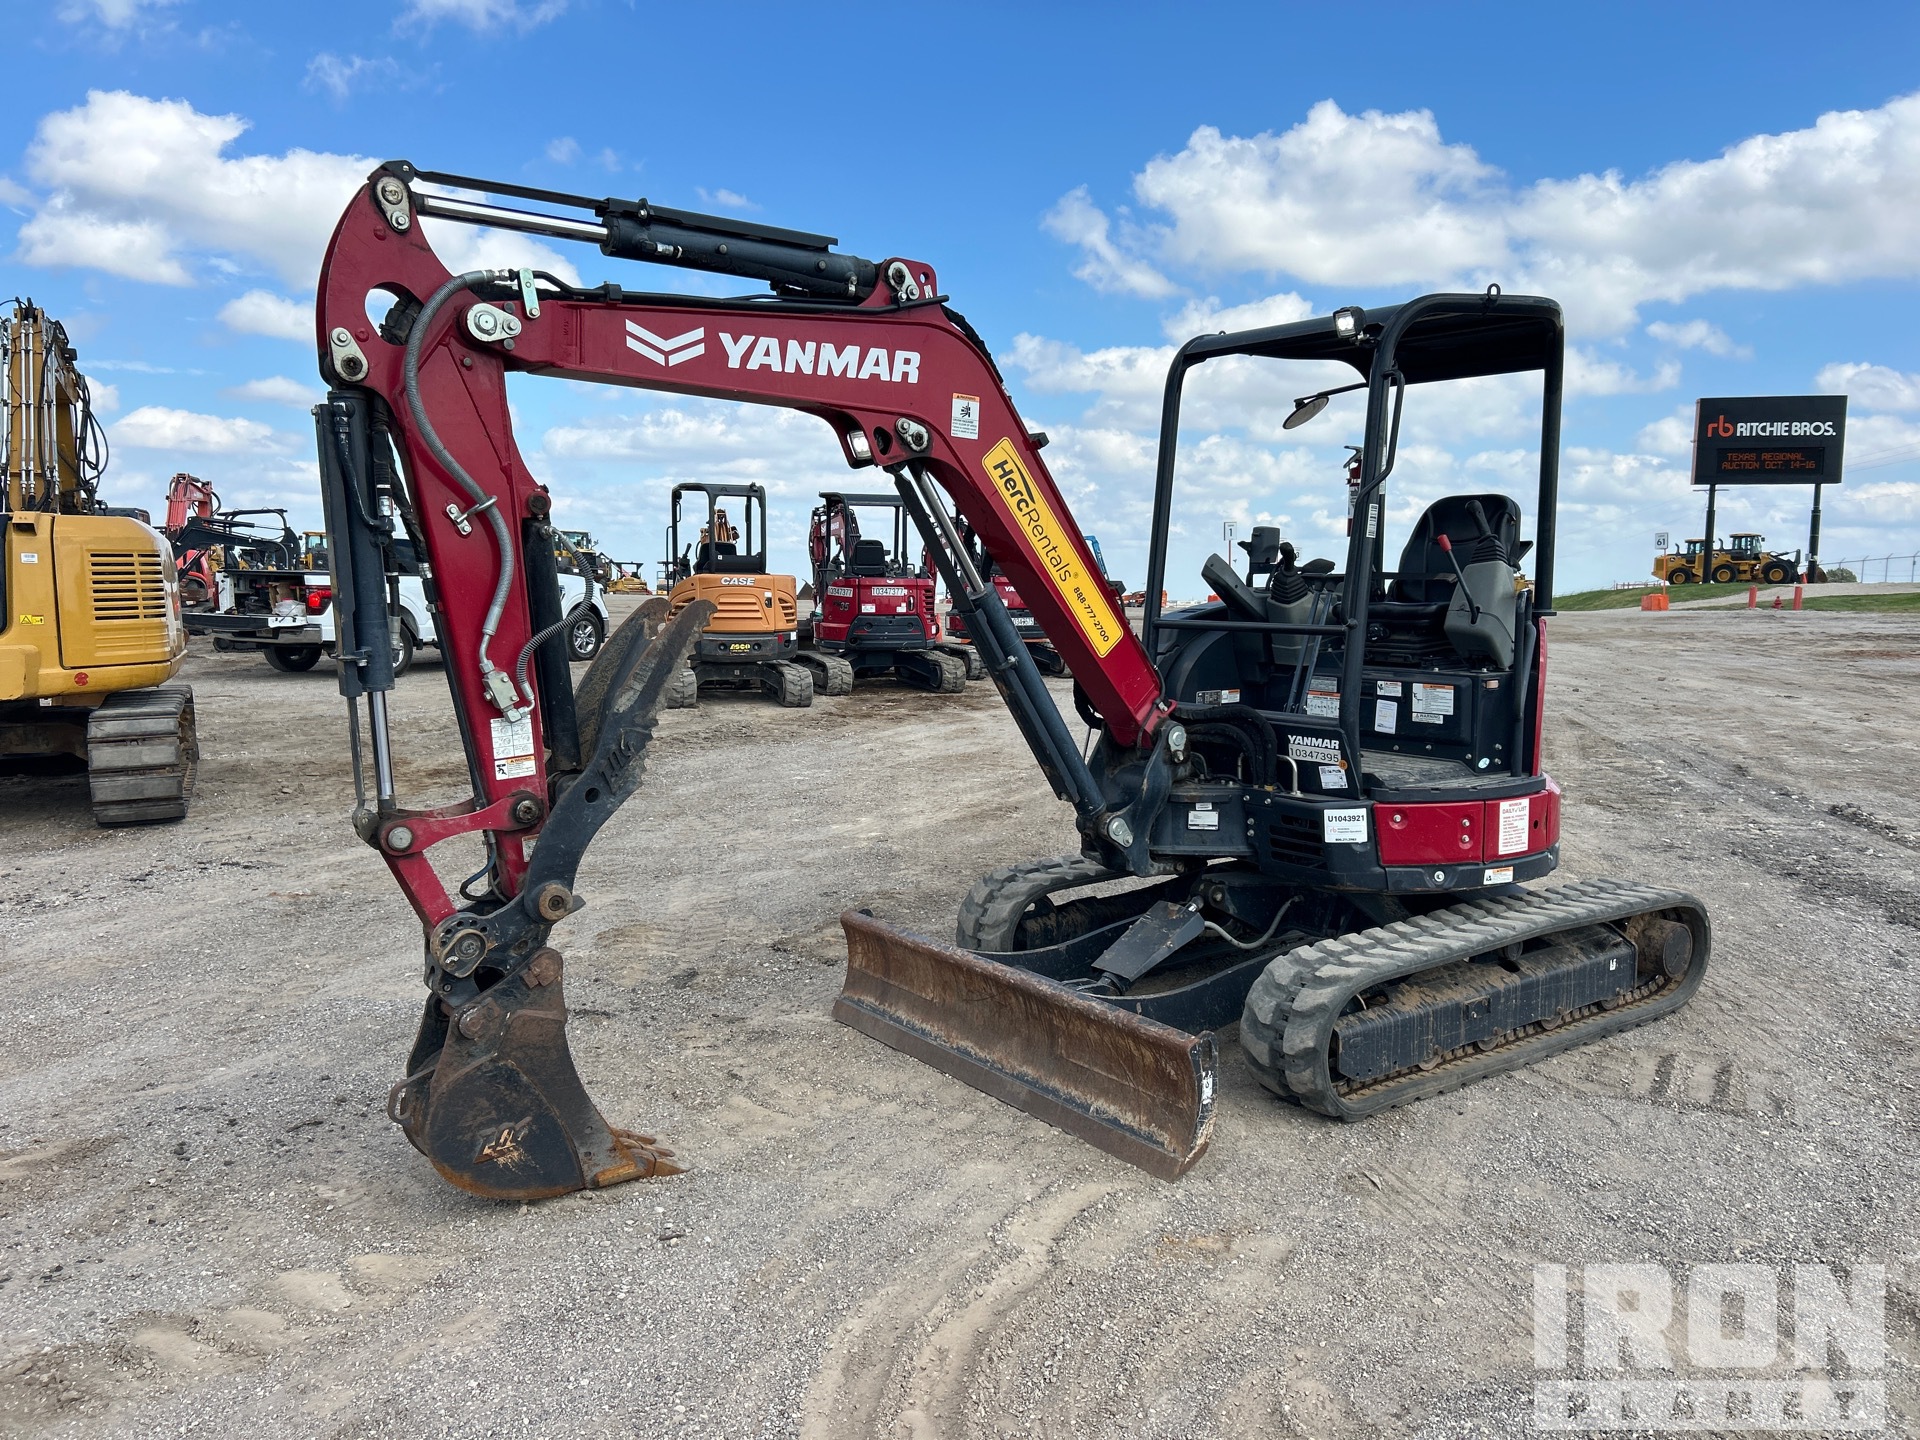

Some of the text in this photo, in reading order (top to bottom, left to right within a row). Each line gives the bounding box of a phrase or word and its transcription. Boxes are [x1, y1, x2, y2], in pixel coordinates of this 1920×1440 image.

[718, 332, 921, 384] YANMAR
[1707, 415, 1837, 438] rb RITCHIE BROS.
[1727, 452, 1805, 461] TEXAS REGIONAL
[1722, 461, 1816, 470] AUCTION OCT. 14-16
[1656, 538, 1666, 546] 61
[720, 577, 756, 586] CASE
[872, 587, 904, 595] 10347377
[1073, 586, 1110, 643] 888-777-2700
[1287, 734, 1340, 750] YANMAR
[1290, 747, 1339, 763] 10347395
[1327, 814, 1365, 823] U1043921
